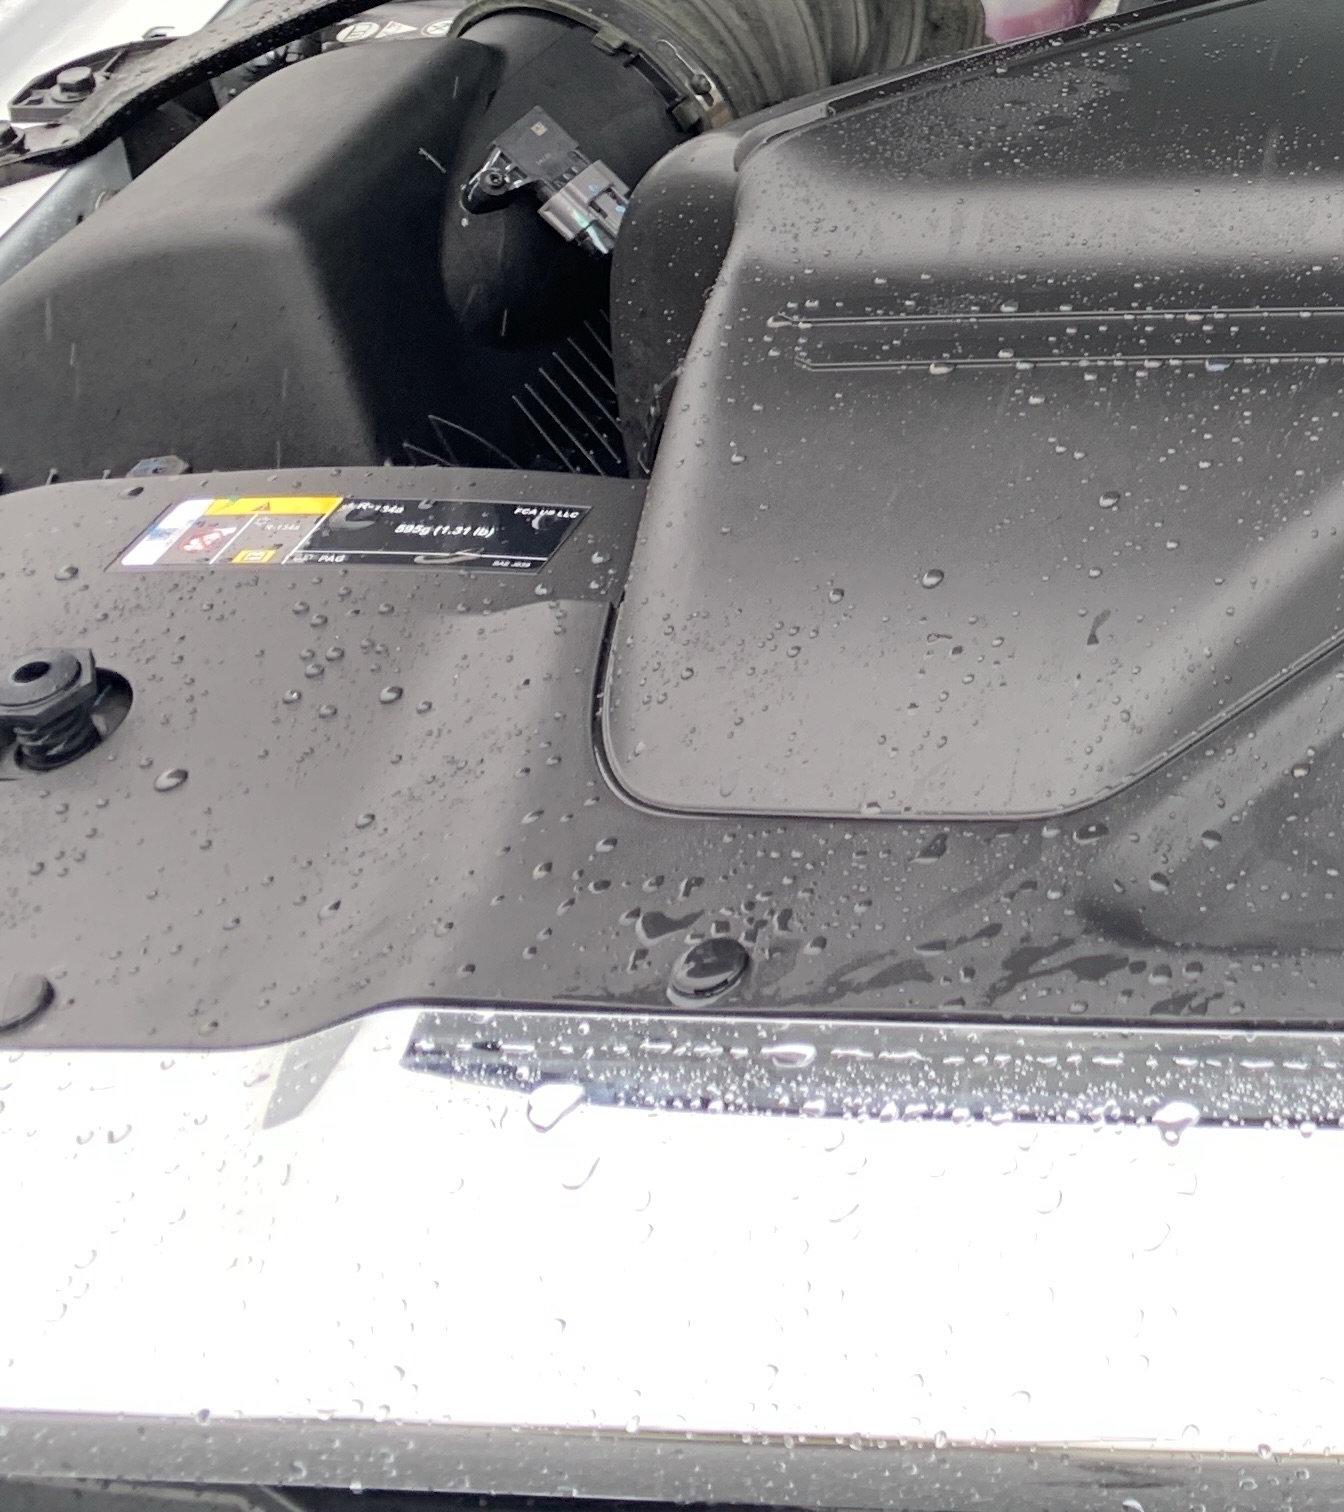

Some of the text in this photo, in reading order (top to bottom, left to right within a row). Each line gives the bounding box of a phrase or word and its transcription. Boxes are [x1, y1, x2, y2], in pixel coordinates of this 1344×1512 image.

[513, 506, 538, 516] FCA
[556, 509, 580, 519] LLC
[472, 526, 496, 539] lb)
